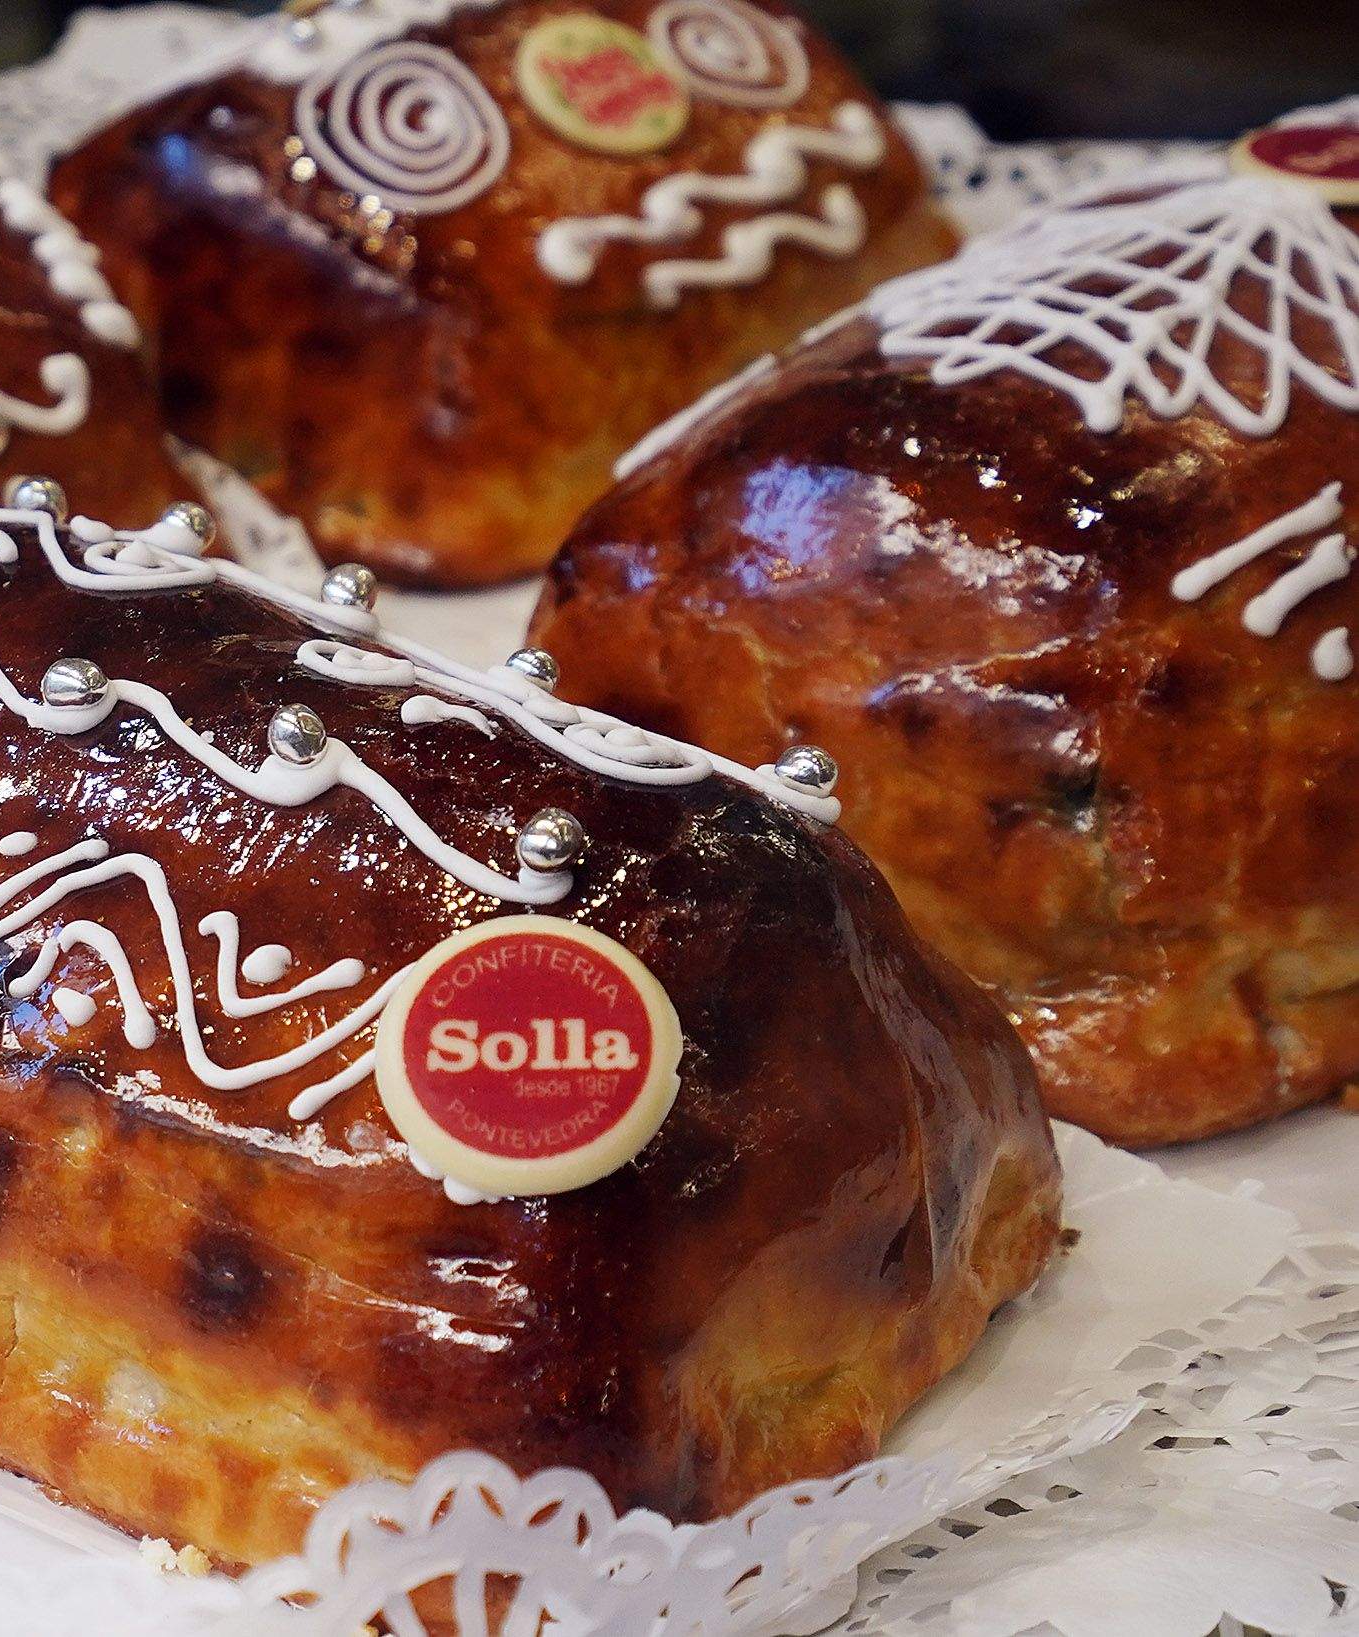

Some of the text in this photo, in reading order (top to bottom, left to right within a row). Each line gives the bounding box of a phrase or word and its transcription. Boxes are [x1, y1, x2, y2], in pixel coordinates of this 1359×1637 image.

[432, 944, 621, 1008] CONFITERIA
[426, 1018, 639, 1072] Solla
[514, 1074, 620, 1097] desde 1967
[447, 1099, 610, 1149] PONTEVEDRA
